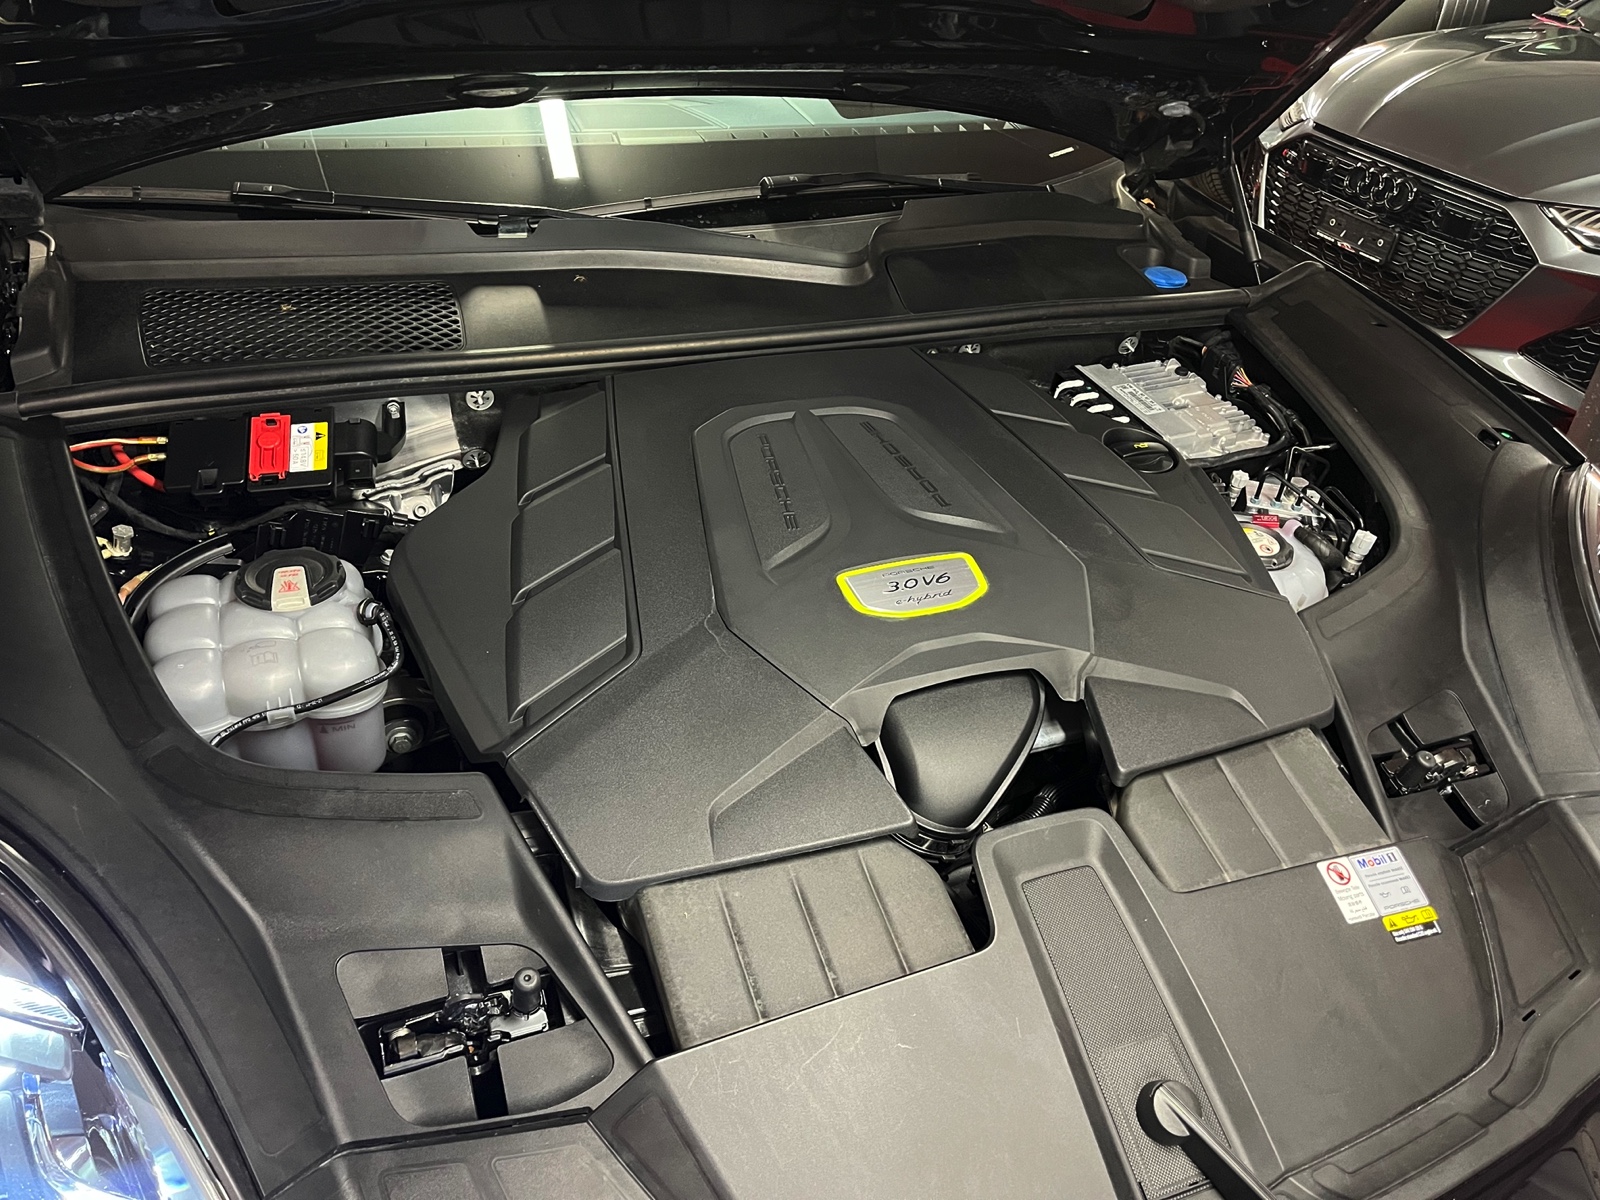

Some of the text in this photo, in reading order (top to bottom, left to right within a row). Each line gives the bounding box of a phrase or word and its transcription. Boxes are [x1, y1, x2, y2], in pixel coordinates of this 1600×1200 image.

[859, 421, 951, 507] PORSCHE
[757, 434, 799, 530] PORSCHE
[882, 565, 935, 577] PORSCHE
[895, 589, 953, 605] e-hybrid
[332, 723, 356, 732] MIN
[1357, 853, 1387, 869] Mobil
